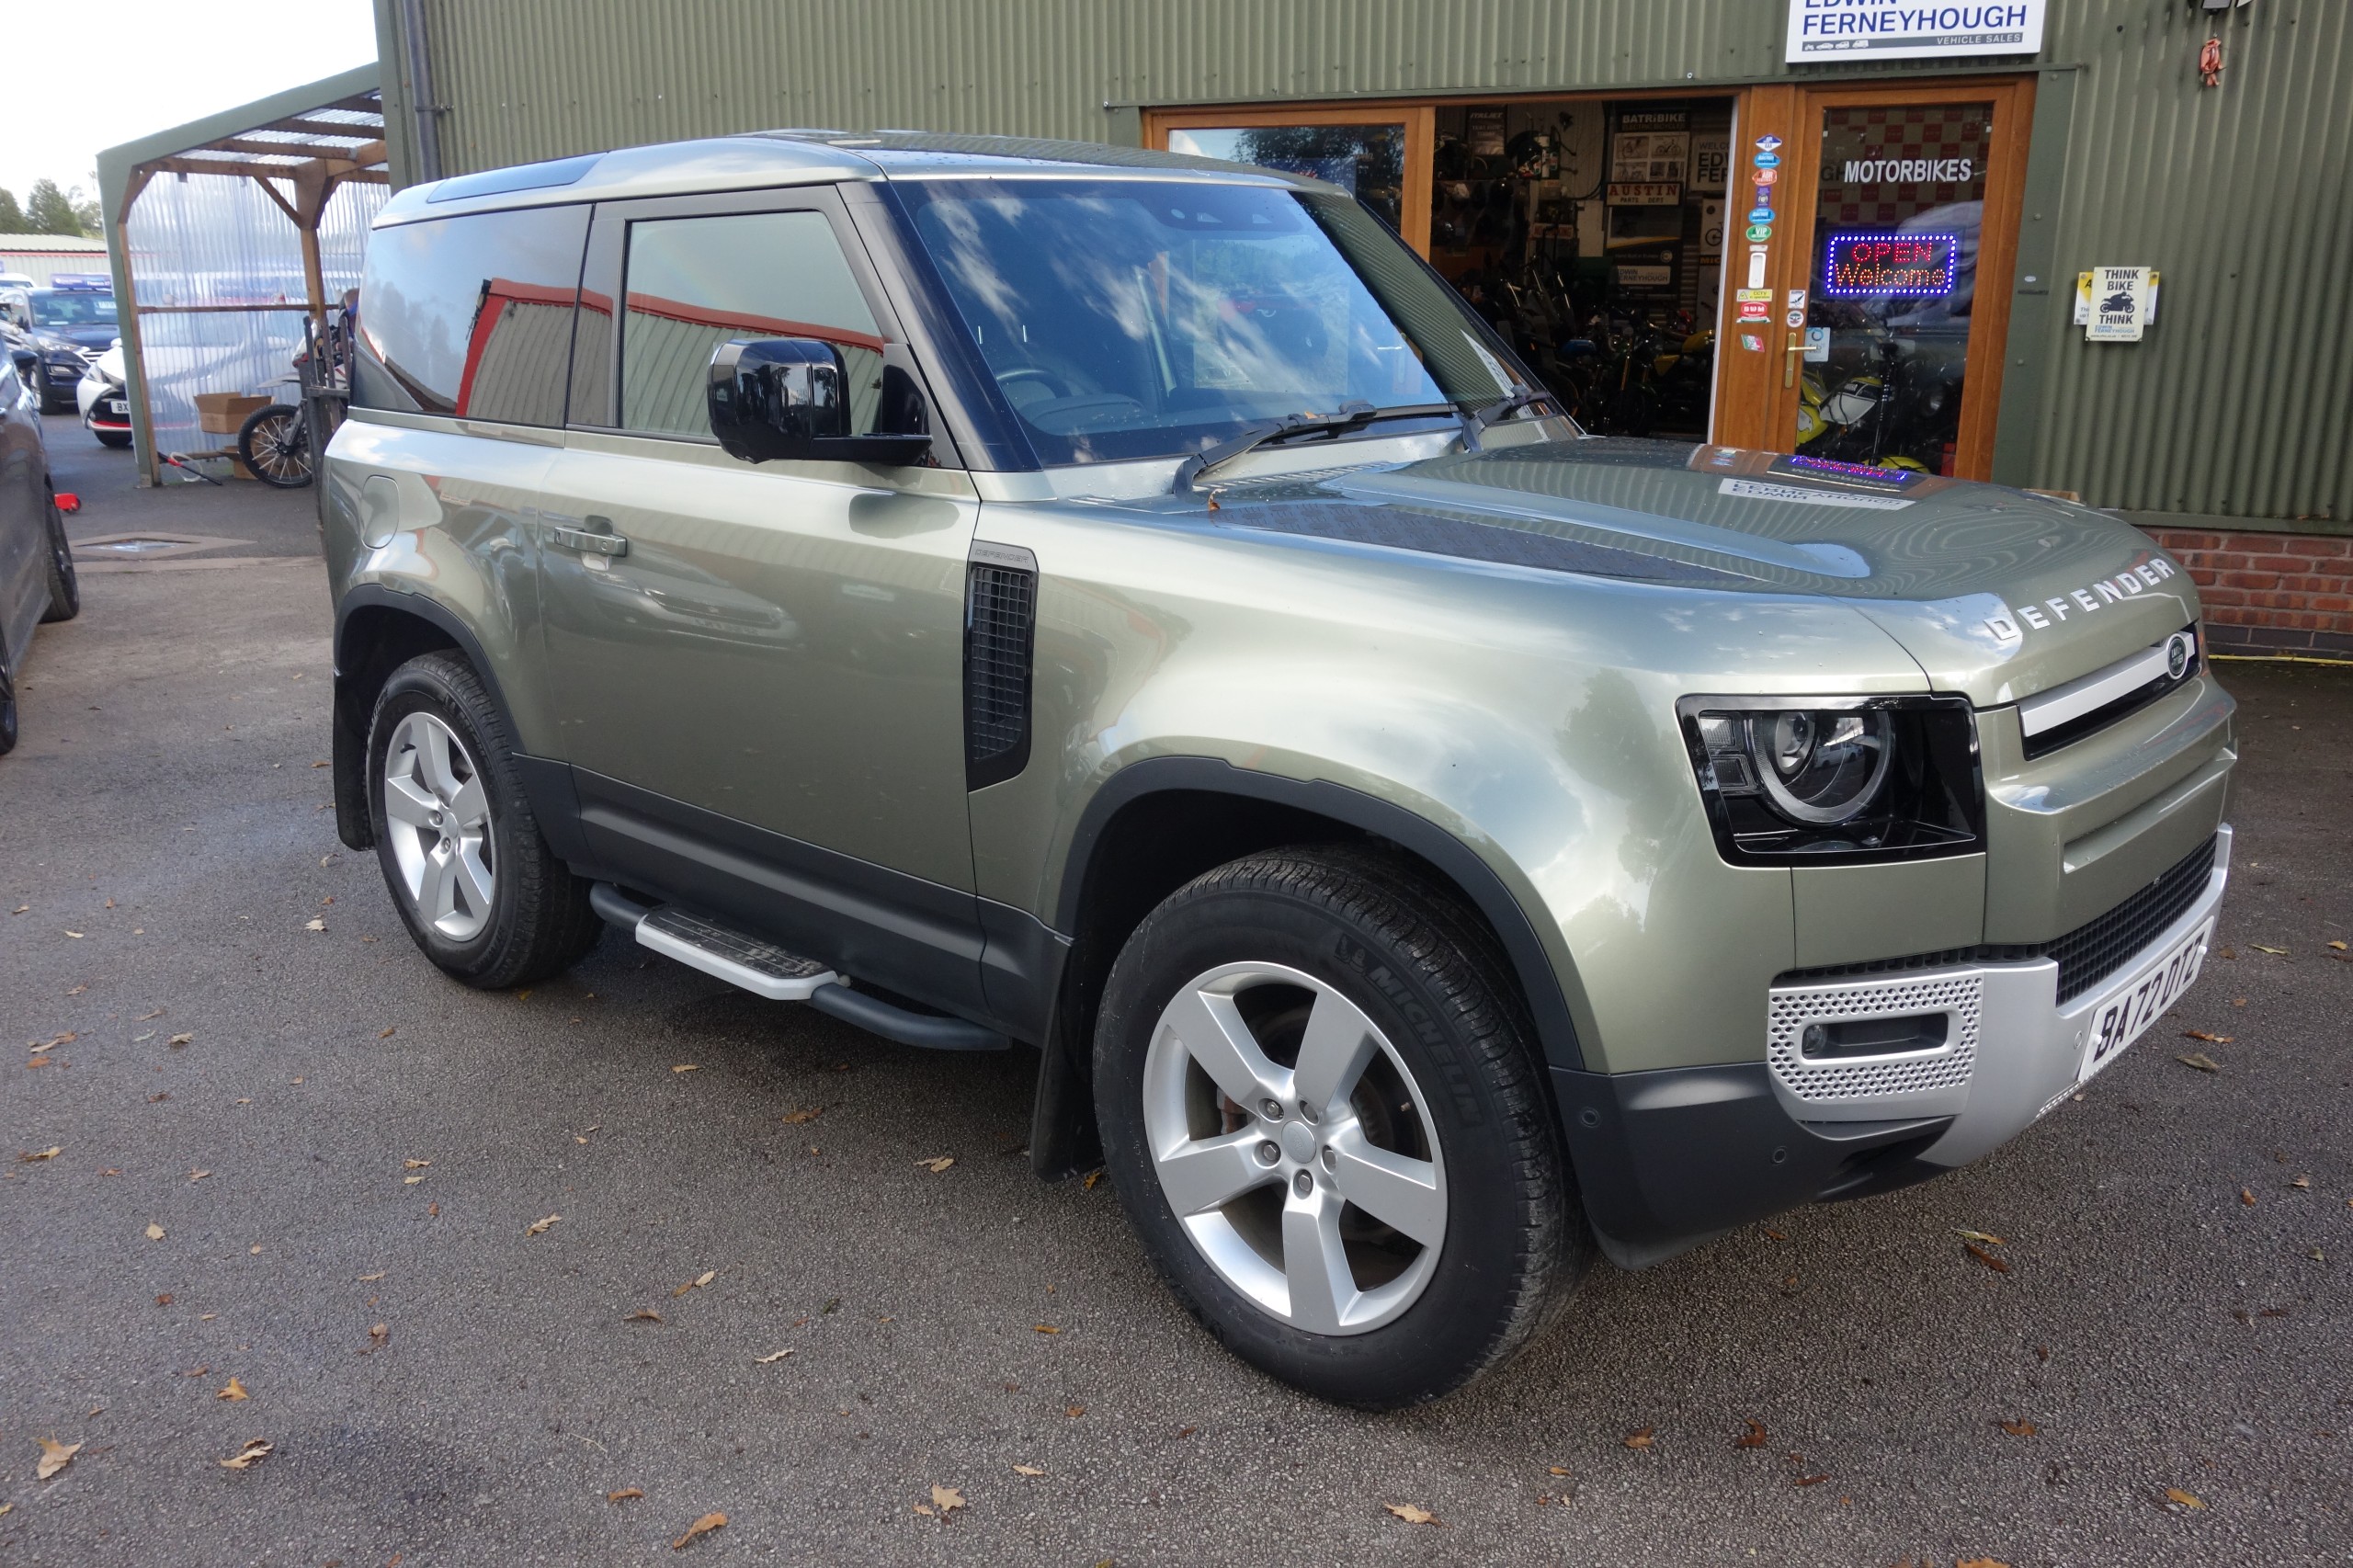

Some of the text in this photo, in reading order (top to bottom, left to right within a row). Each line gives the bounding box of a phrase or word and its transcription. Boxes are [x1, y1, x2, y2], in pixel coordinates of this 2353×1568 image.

[1802, 5, 2027, 35] FERNEYHOUGH
[1937, 33, 2020, 45] VEHICLE SALES
[1844, 158, 1972, 183] MOTORBIKES
[1608, 185, 1677, 196] AUSTIN
[1852, 243, 1932, 262] OPEN
[1834, 263, 1946, 286] Welcome
[2104, 269, 2139, 279] THINK
[2107, 280, 2134, 290] BIKE
[2099, 314, 2134, 324] THINK
[975, 548, 1029, 564] DEFENDER
[1984, 558, 2176, 641] DEFENDER
[2093, 971, 2164, 1063] BA72
